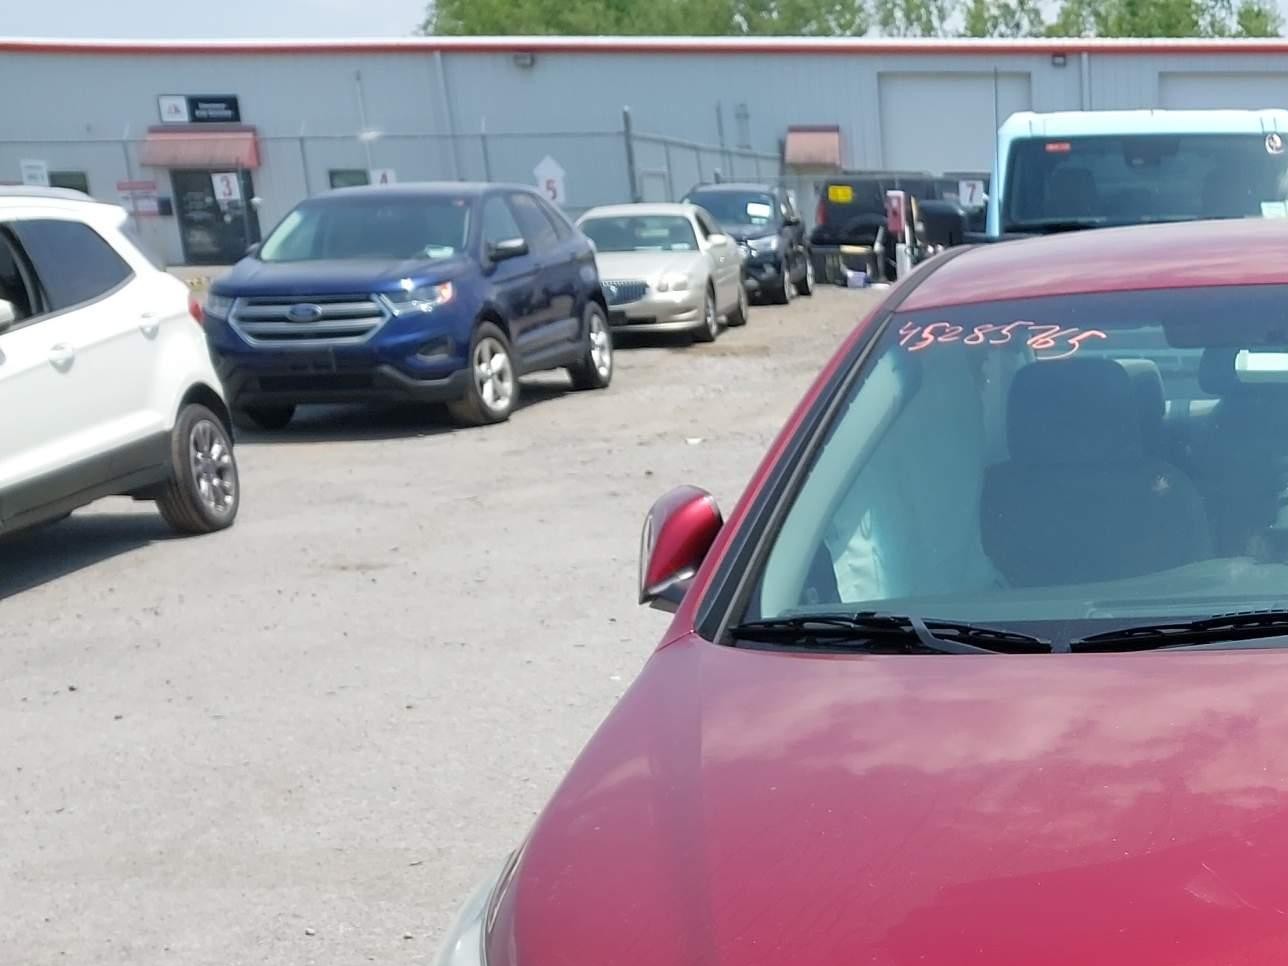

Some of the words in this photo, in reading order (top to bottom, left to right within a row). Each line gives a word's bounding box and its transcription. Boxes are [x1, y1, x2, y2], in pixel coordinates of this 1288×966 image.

[220, 175, 233, 197] 3
[545, 179, 557, 200] 5
[966, 182, 977, 203] 7
[899, 320, 1107, 360] 45285765
